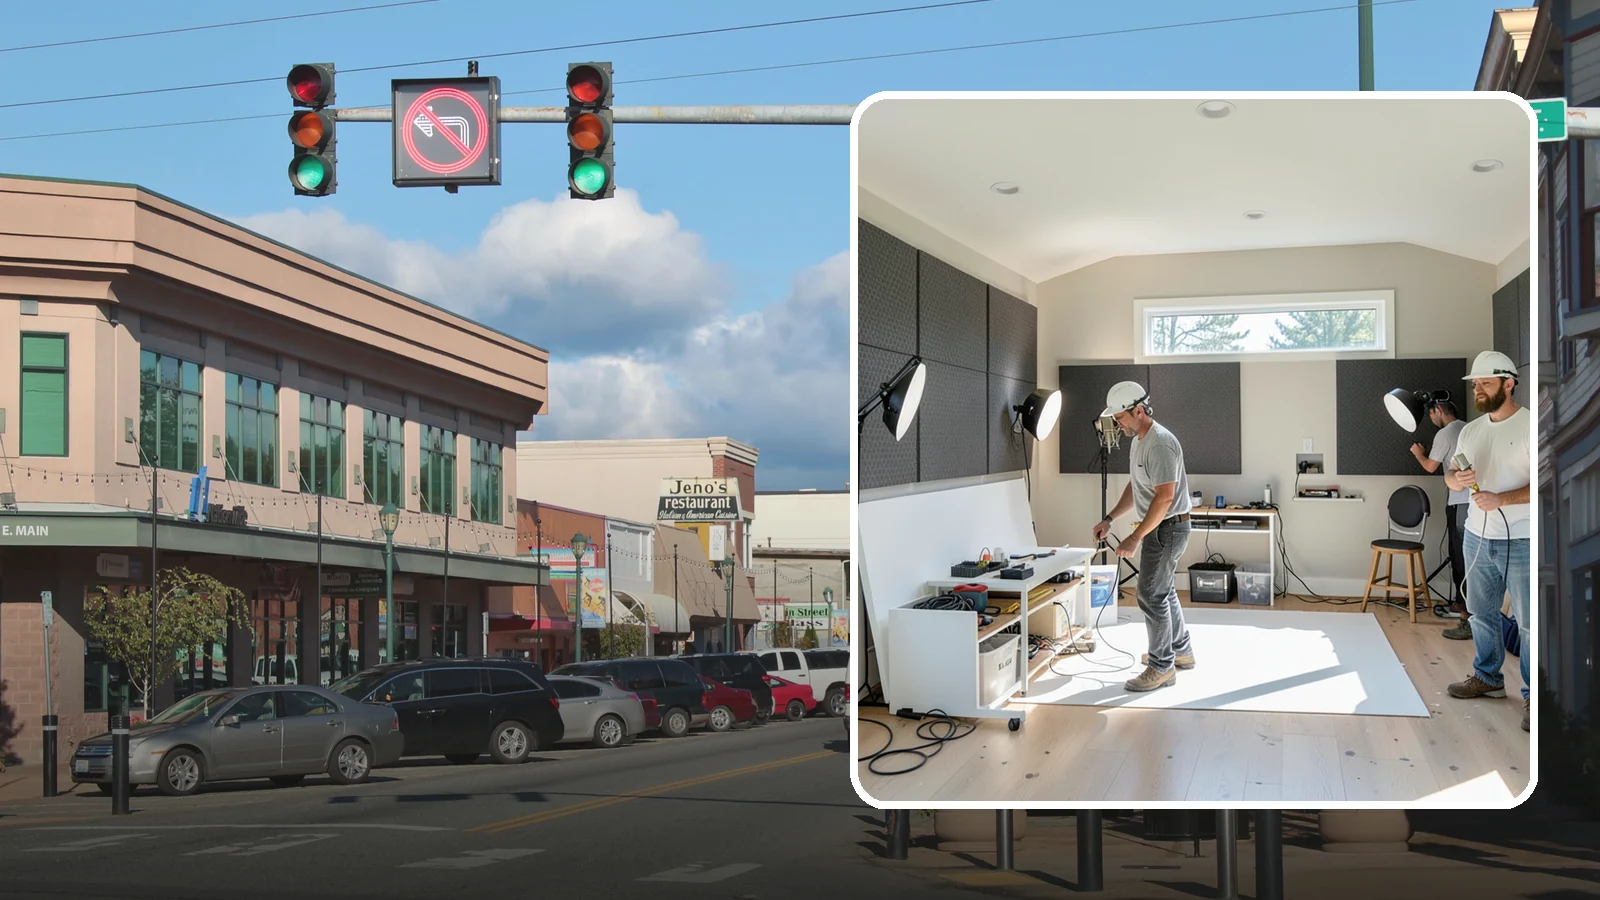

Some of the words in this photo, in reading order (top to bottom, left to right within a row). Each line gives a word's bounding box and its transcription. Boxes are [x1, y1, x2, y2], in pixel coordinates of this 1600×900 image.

[670, 480, 727, 494] Jeno's
[665, 496, 731, 509] restaurant
[658, 510, 681, 519] Italian
[686, 509, 714, 519] American
[714, 509, 737, 519] Cuisine
[2, 525, 13, 536] E.
[15, 525, 49, 536] MAIN
[797, 608, 828, 616] Street
